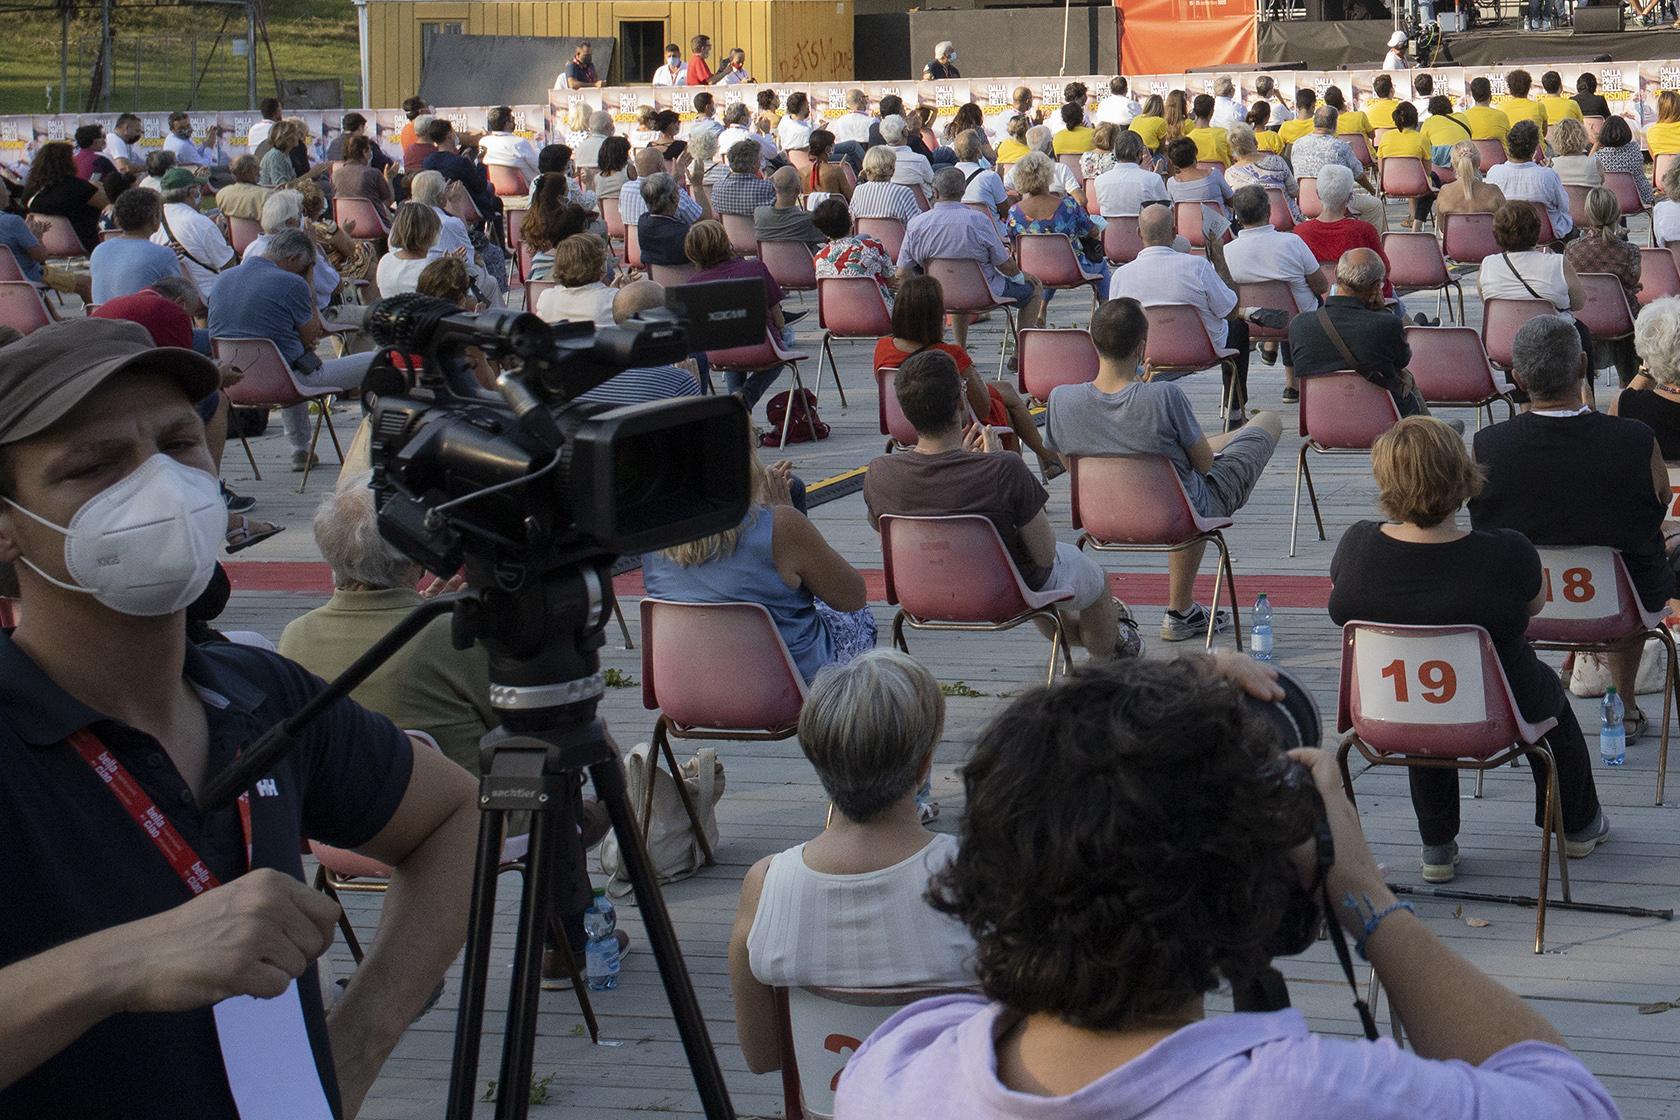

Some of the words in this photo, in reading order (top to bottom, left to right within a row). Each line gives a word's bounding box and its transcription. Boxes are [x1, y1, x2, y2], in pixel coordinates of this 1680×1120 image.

[988, 84, 1006, 92] DALLA
[988, 97, 1007, 105] DELLE
[1381, 659, 1457, 704] 19
[97, 751, 118, 773] bella
[95, 765, 112, 783] ciao
[146, 805, 166, 828] bella
[143, 820, 160, 838] ciao
[191, 861, 210, 883] bella
[187, 876, 204, 895] ciao
